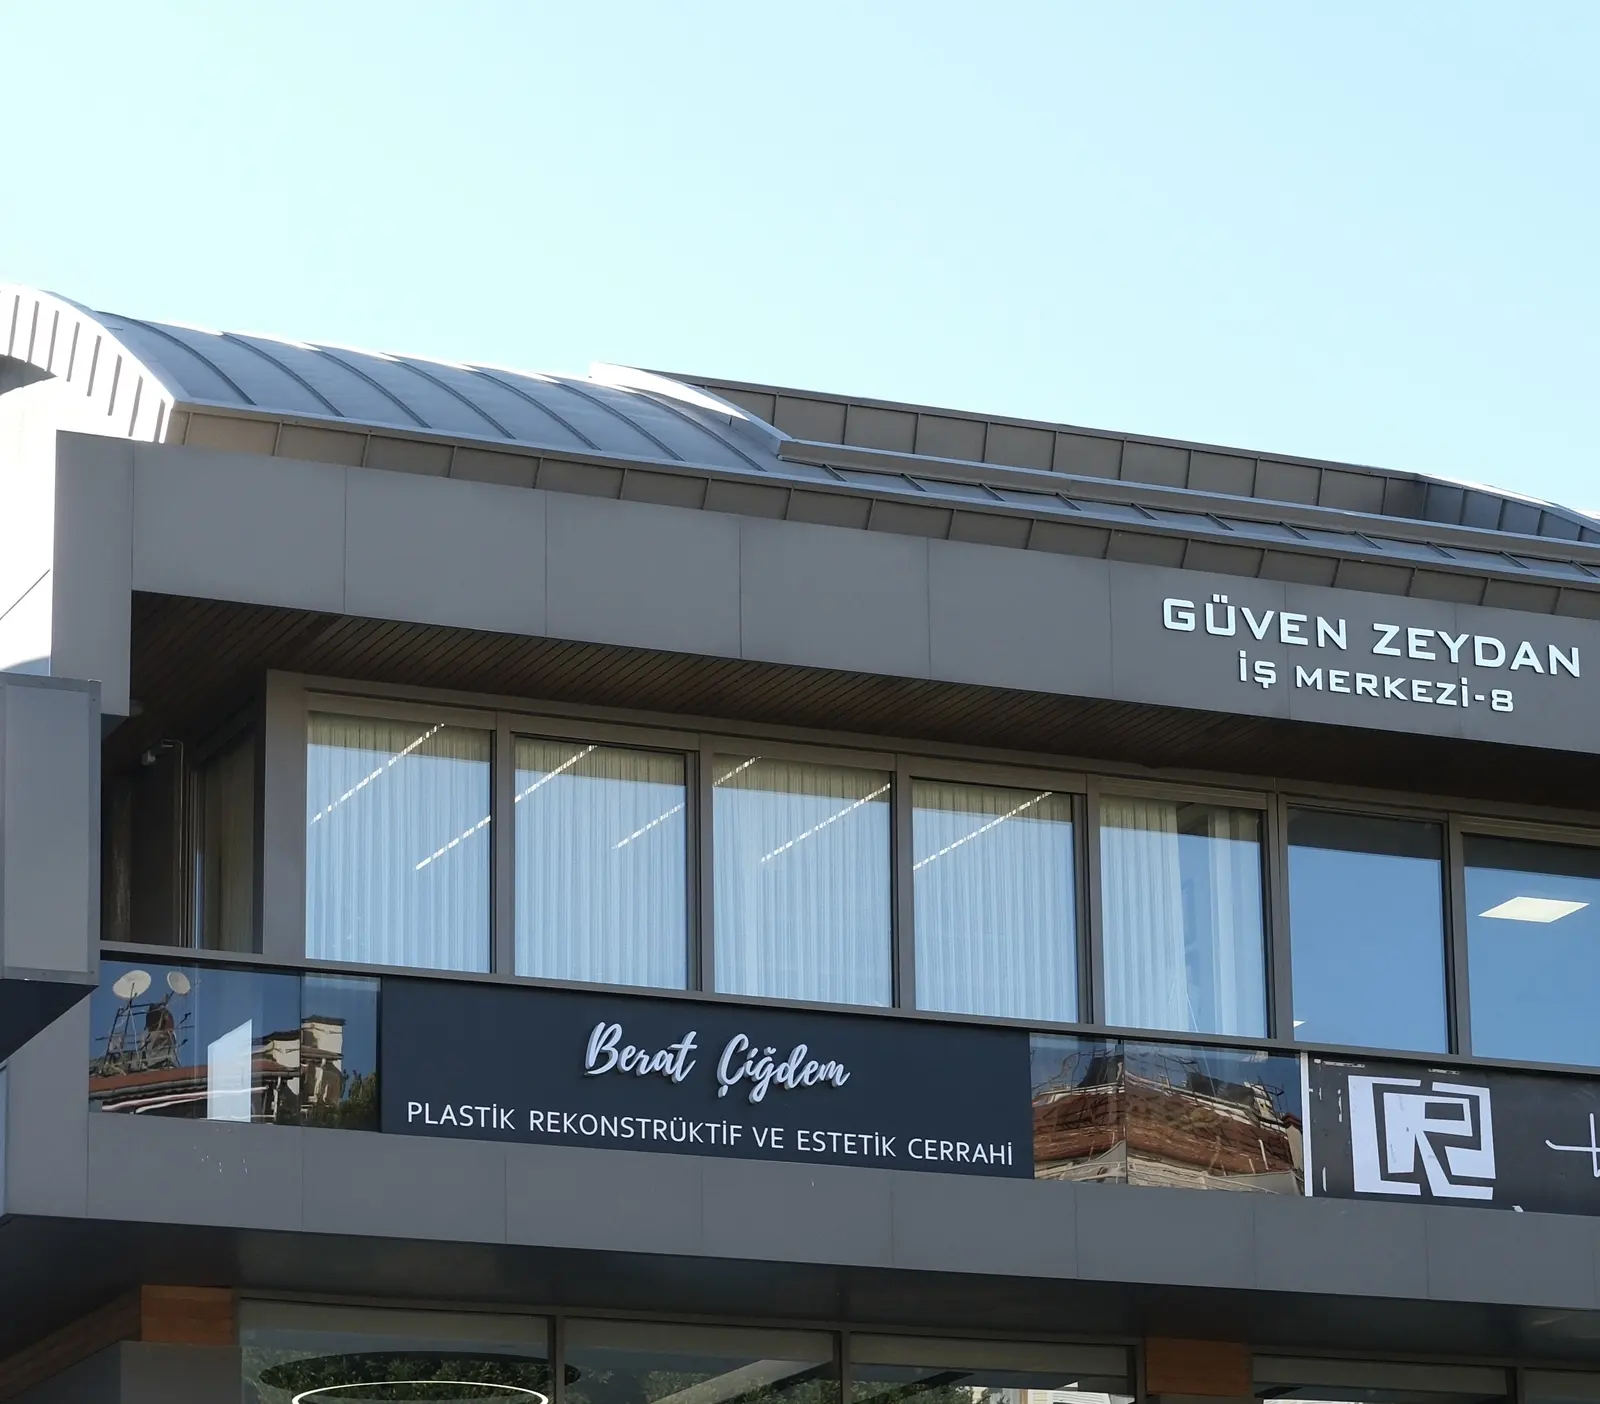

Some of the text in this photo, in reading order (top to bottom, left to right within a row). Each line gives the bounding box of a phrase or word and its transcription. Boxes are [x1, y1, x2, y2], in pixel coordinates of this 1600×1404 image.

[1163, 594, 1580, 678] GÜVEN ZEYDAN
[1239, 650, 1514, 712] İŞ MERKEZİ-8
[584, 1021, 851, 1103] Berat Çiğdem
[407, 1101, 1013, 1167] PLASTİK REKONSTRÜKTİF VE ESTETİK CERRAHİ
